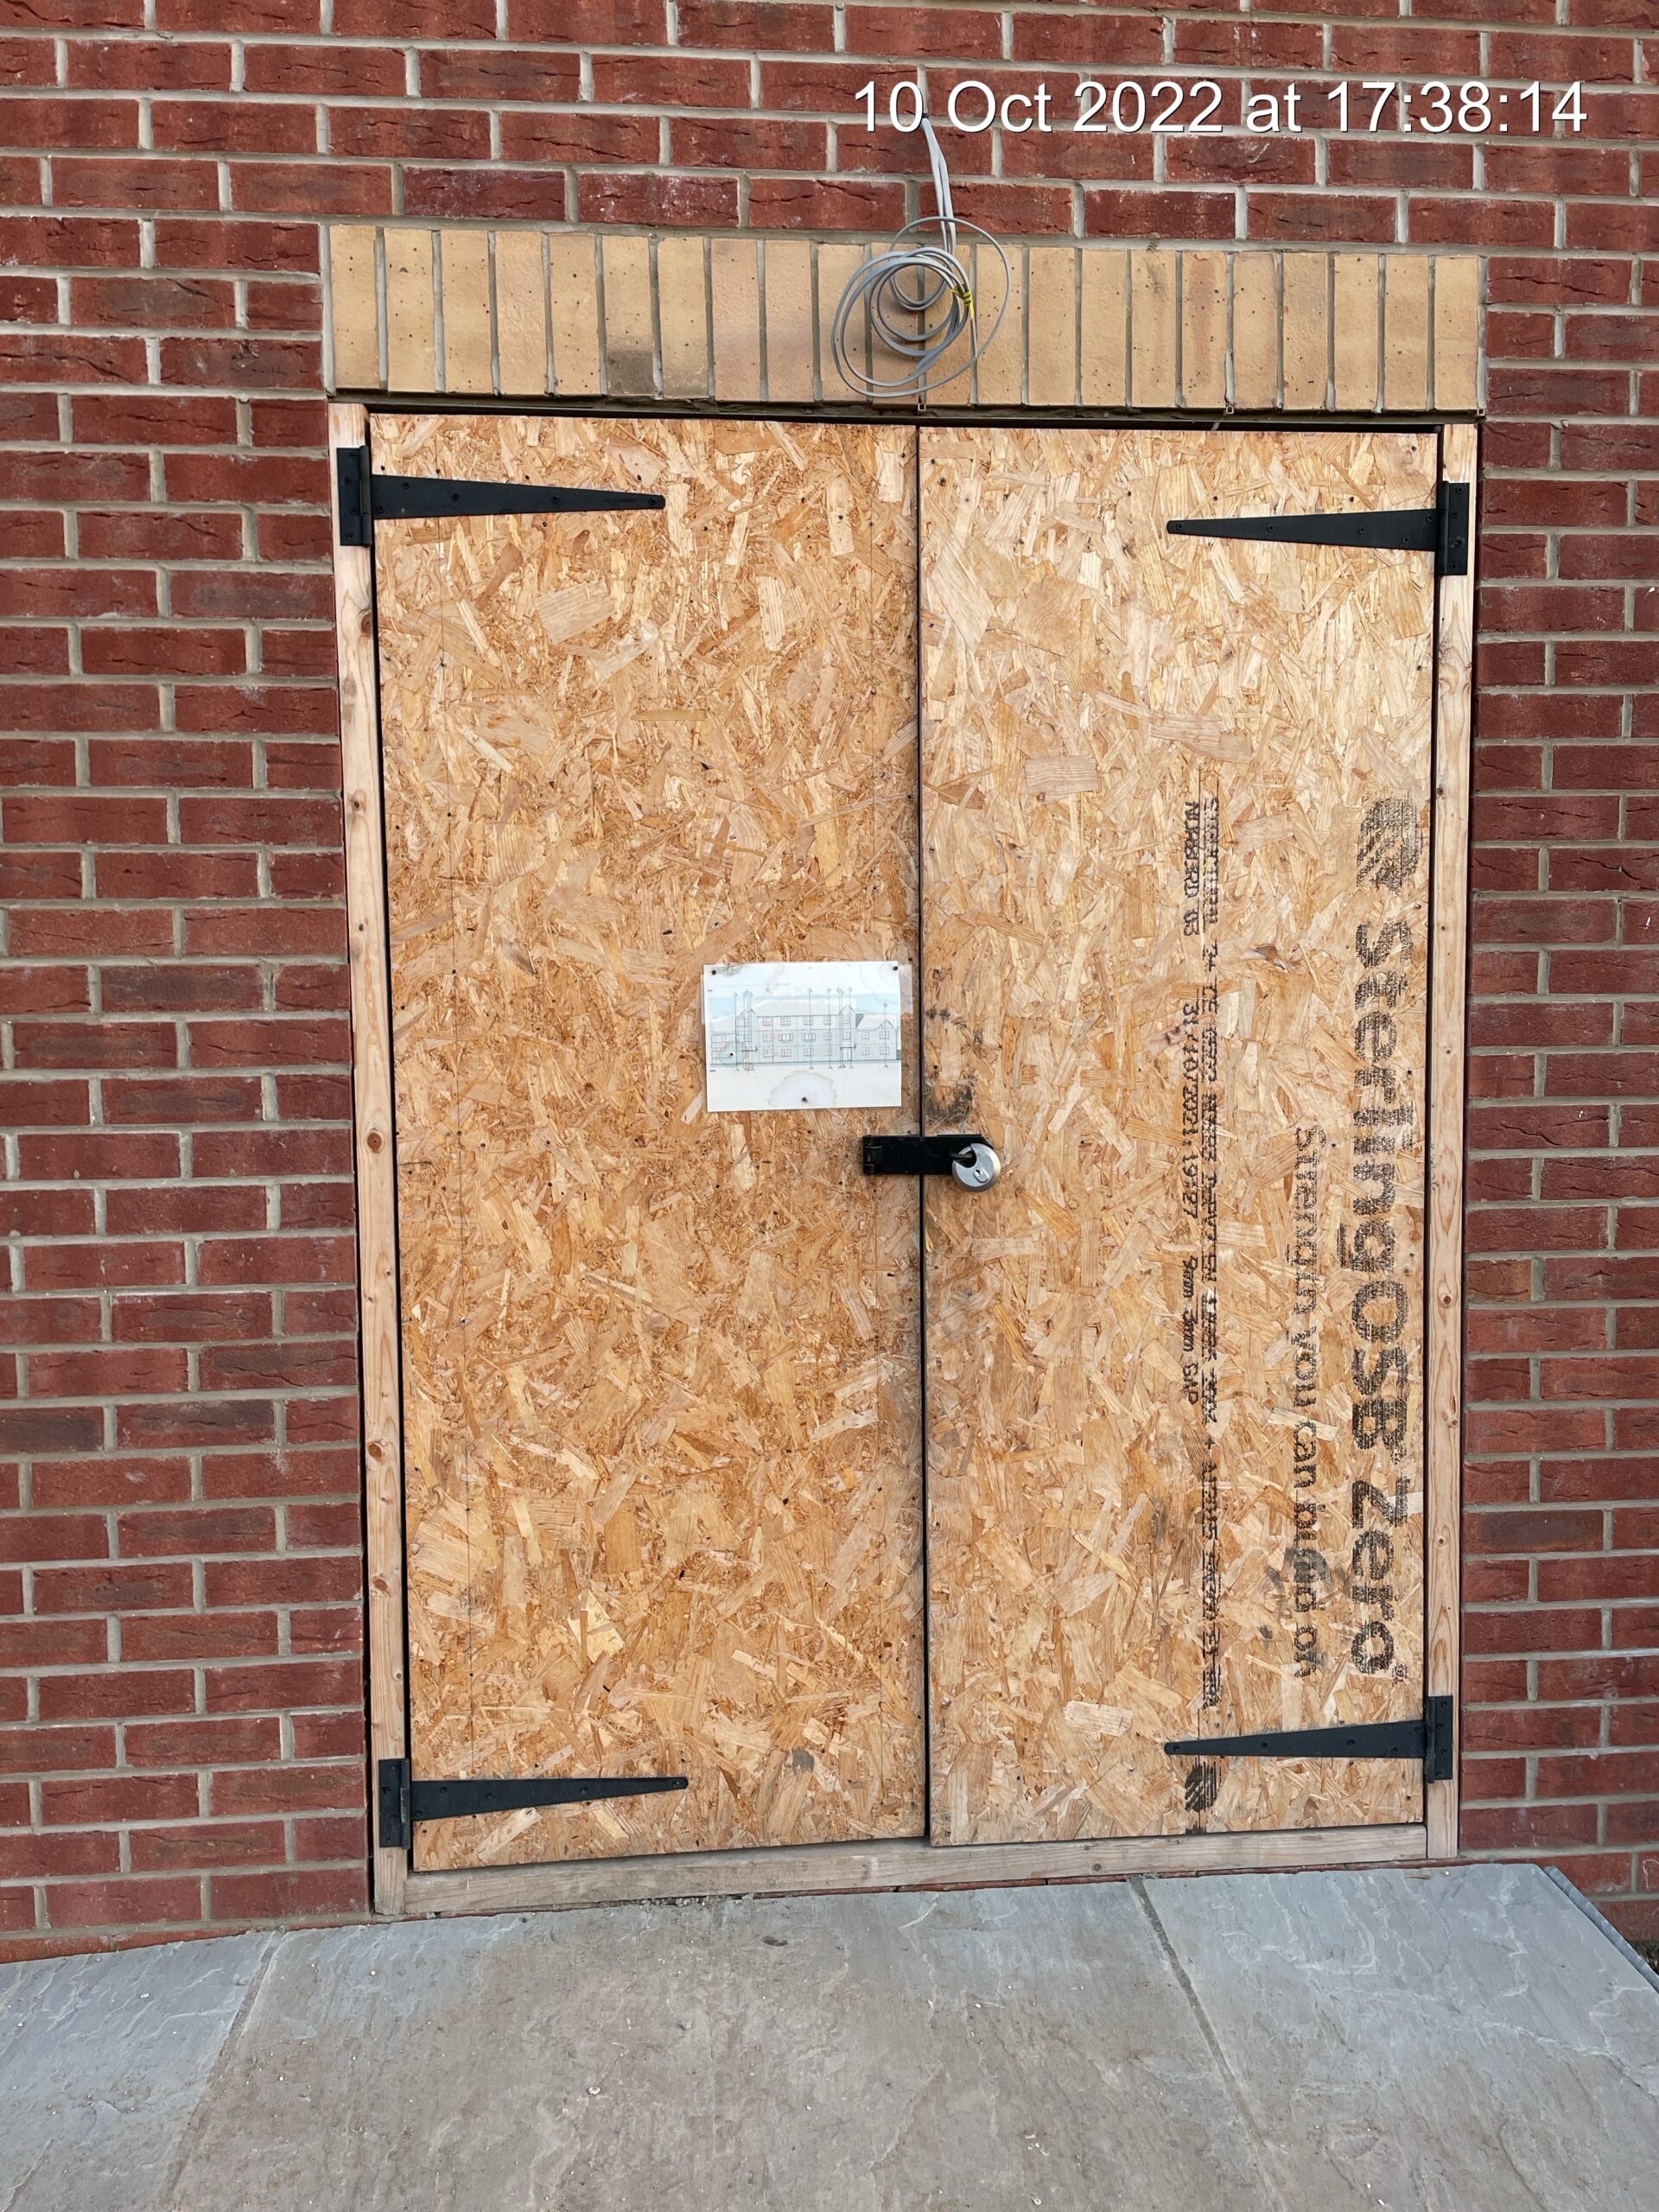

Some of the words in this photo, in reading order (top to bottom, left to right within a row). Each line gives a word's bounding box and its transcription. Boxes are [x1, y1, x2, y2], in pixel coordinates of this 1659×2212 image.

[1285, 1326, 1317, 1408] you
[1292, 1421, 1317, 1490] can
[1351, 1479, 1409, 1676] Zero
[1292, 1624, 1317, 1679] on
